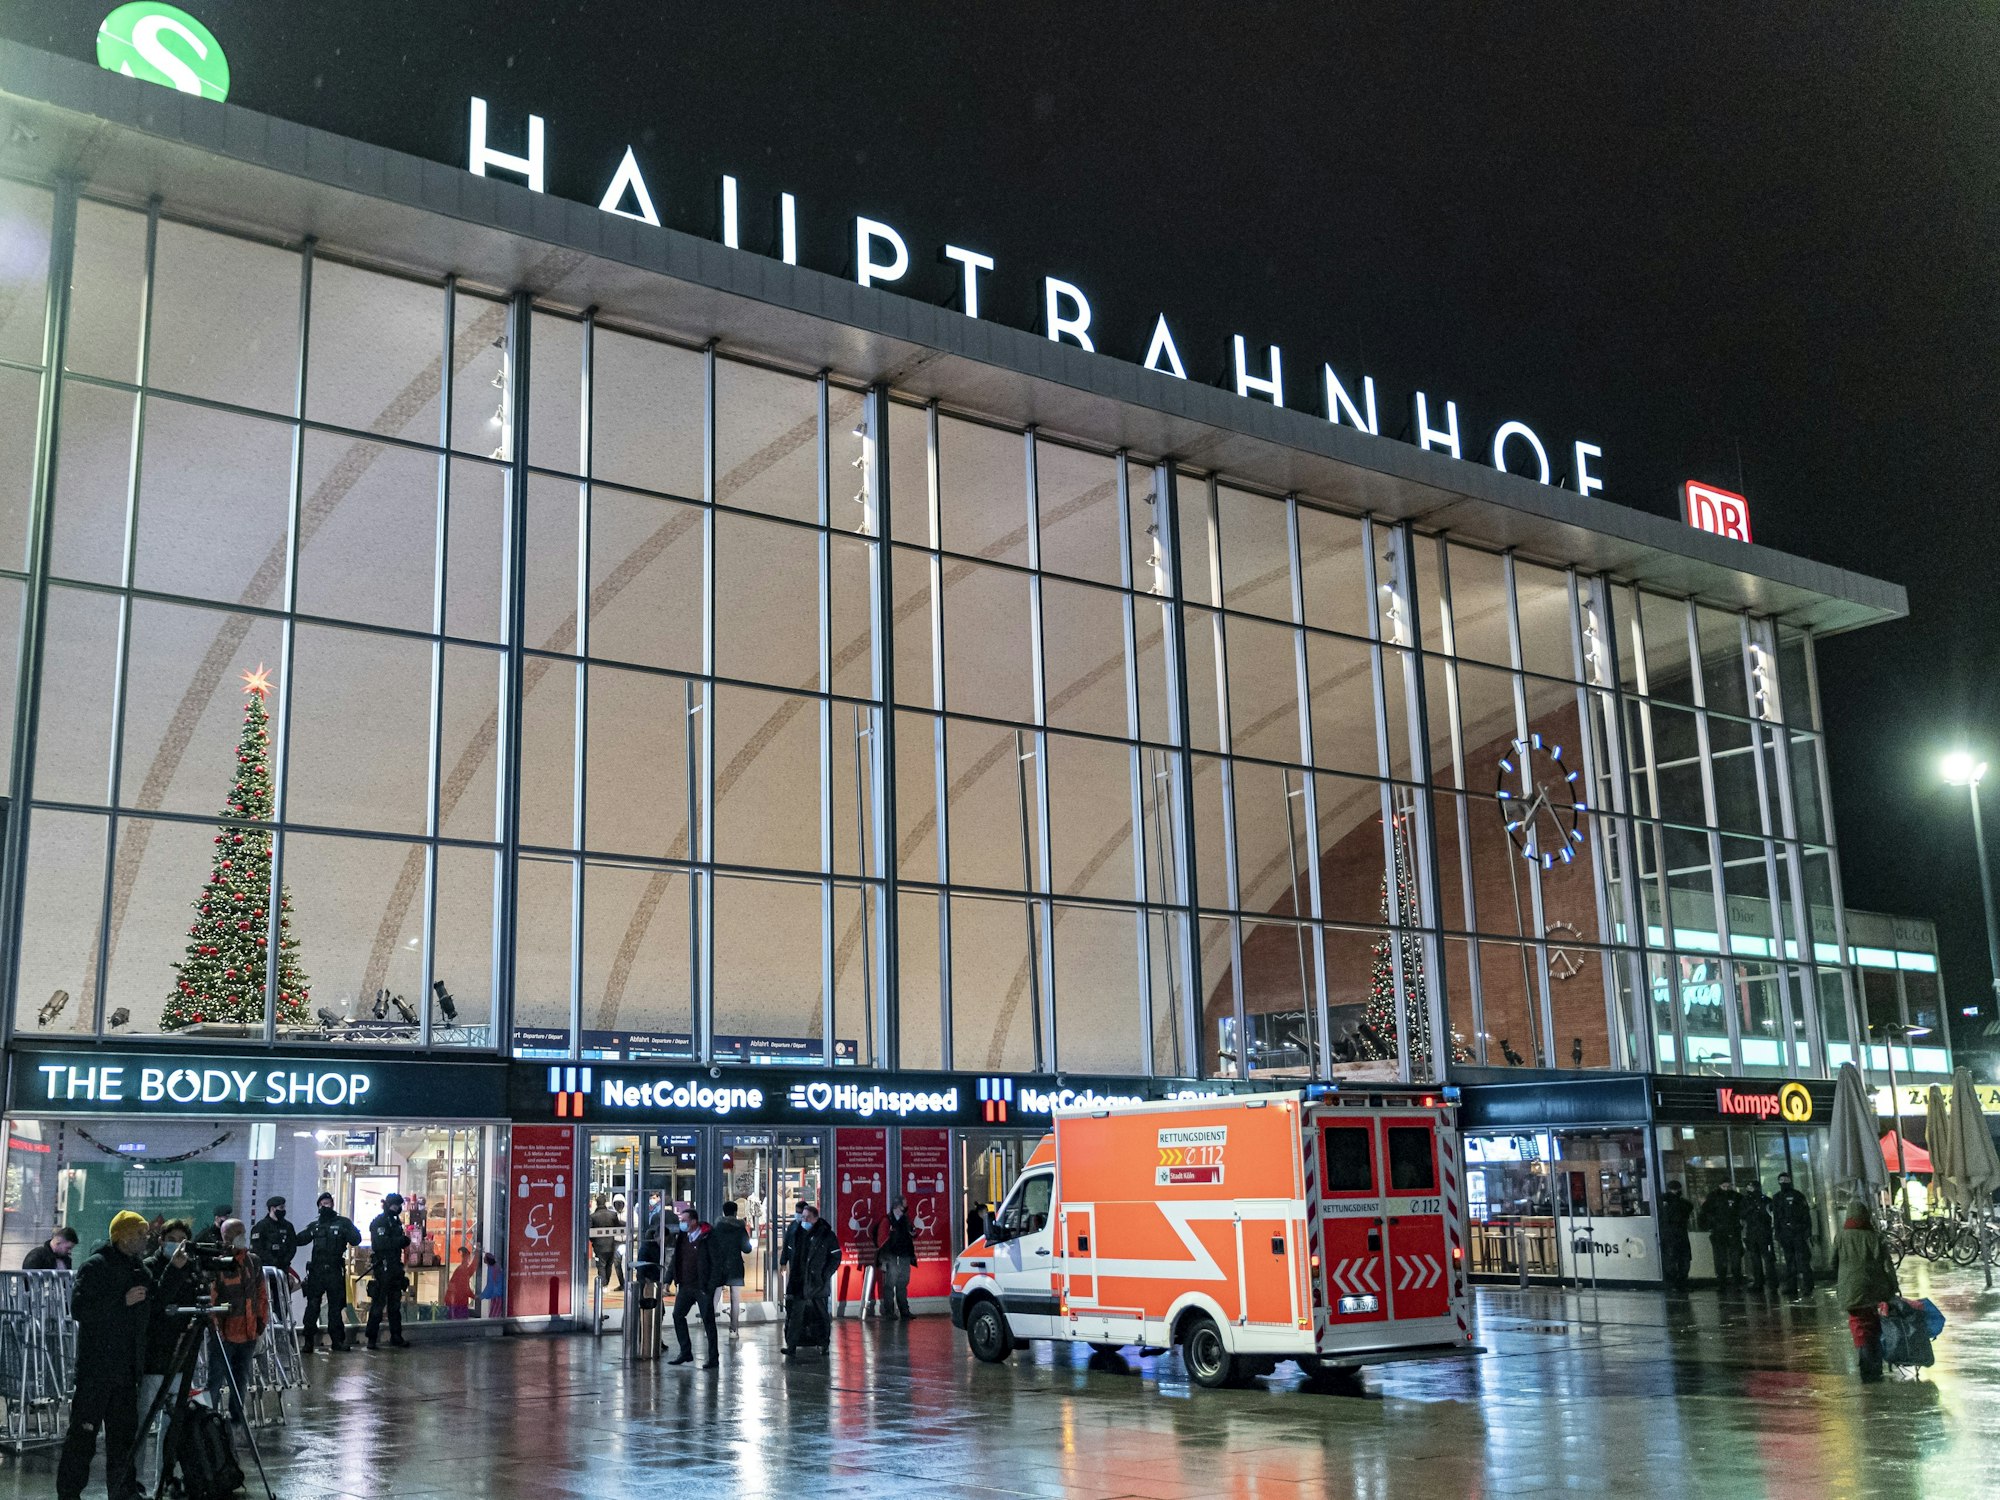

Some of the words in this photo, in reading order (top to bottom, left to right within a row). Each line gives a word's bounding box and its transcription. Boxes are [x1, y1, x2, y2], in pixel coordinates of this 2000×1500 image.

[467, 95, 1604, 498] HAUPTBAHNHOF
[1695, 493, 1744, 542] DB
[39, 1066, 124, 1101] THE
[140, 1068, 257, 1103] BODY
[265, 1072, 370, 1105] SHOP
[602, 1079, 763, 1115] NetCologne
[834, 1083, 958, 1117] Highspeed
[1716, 1088, 1781, 1118] Kamps
[1160, 1130, 1225, 1143] RETTUNGSDIENST
[1200, 1146, 1224, 1165] 112
[1170, 1172, 1183, 1180] Stadt
[1323, 1202, 1379, 1213] RETTUNGSDIENST
[1423, 1199, 1440, 1213] 112
